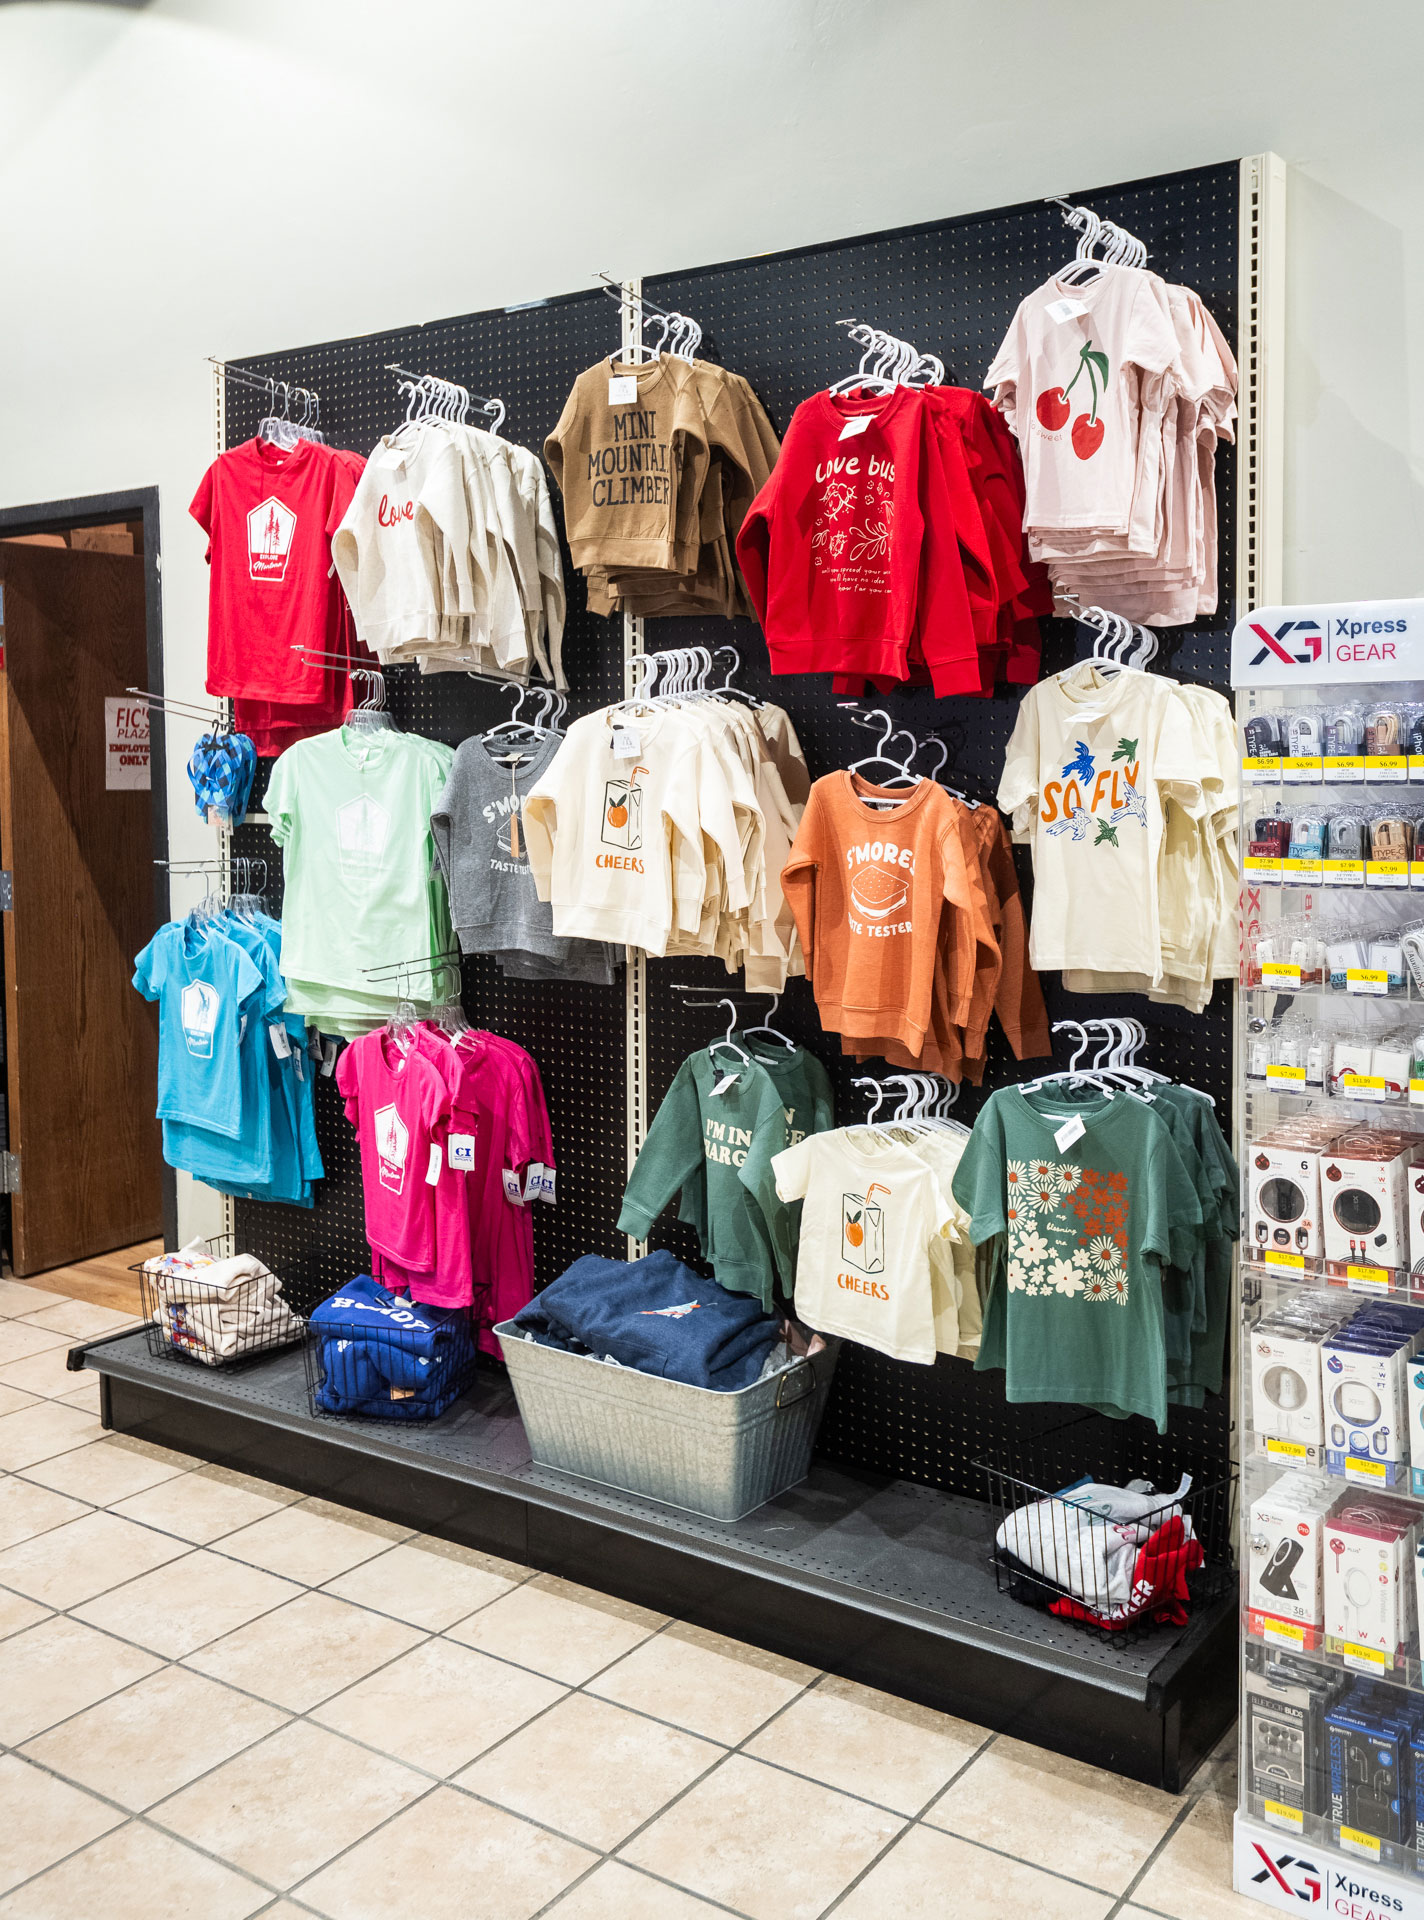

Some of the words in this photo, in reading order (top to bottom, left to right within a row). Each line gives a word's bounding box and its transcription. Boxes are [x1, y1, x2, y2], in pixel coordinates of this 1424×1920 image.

[614, 411, 656, 442] MINI
[588, 443, 669, 480] MOUNTAI
[593, 476, 669, 507] CLIMBER
[378, 494, 414, 527] love
[1249, 621, 1322, 665] XG
[1336, 618, 1407, 639] Xpress
[1336, 643, 1396, 662] GEAR
[1248, 736, 1258, 757] TYPE-
[1291, 736, 1299, 757] TYPE-
[1328, 736, 1336, 756] TYPE-
[119, 754, 150, 765] ONLY
[1041, 779, 1082, 823] SO
[1091, 760, 1140, 813] FLY
[490, 859, 518, 874] TASTE
[596, 854, 645, 874] CHEERS
[867, 921, 912, 937] TESTER
[727, 1126, 752, 1147] IN
[455, 1147, 471, 1157] CI
[1301, 1161, 1309, 1170] 6
[508, 1182, 518, 1192] CI
[531, 1176, 541, 1185] CI
[542, 1179, 553, 1189] CI
[1046, 1222, 1077, 1236] blooming
[1358, 1267, 1376, 1275] $17.99
[837, 1273, 889, 1301] CHEERS
[1281, 1446, 1301, 1454] $17.99
[1284, 1707, 1303, 1719] BUDS
[1330, 1736, 1343, 1793] WIRELESS
[1276, 1807, 1296, 1819] $19.99
[1251, 1841, 1321, 1902] XG
[1335, 1872, 1403, 1912] Xpress
